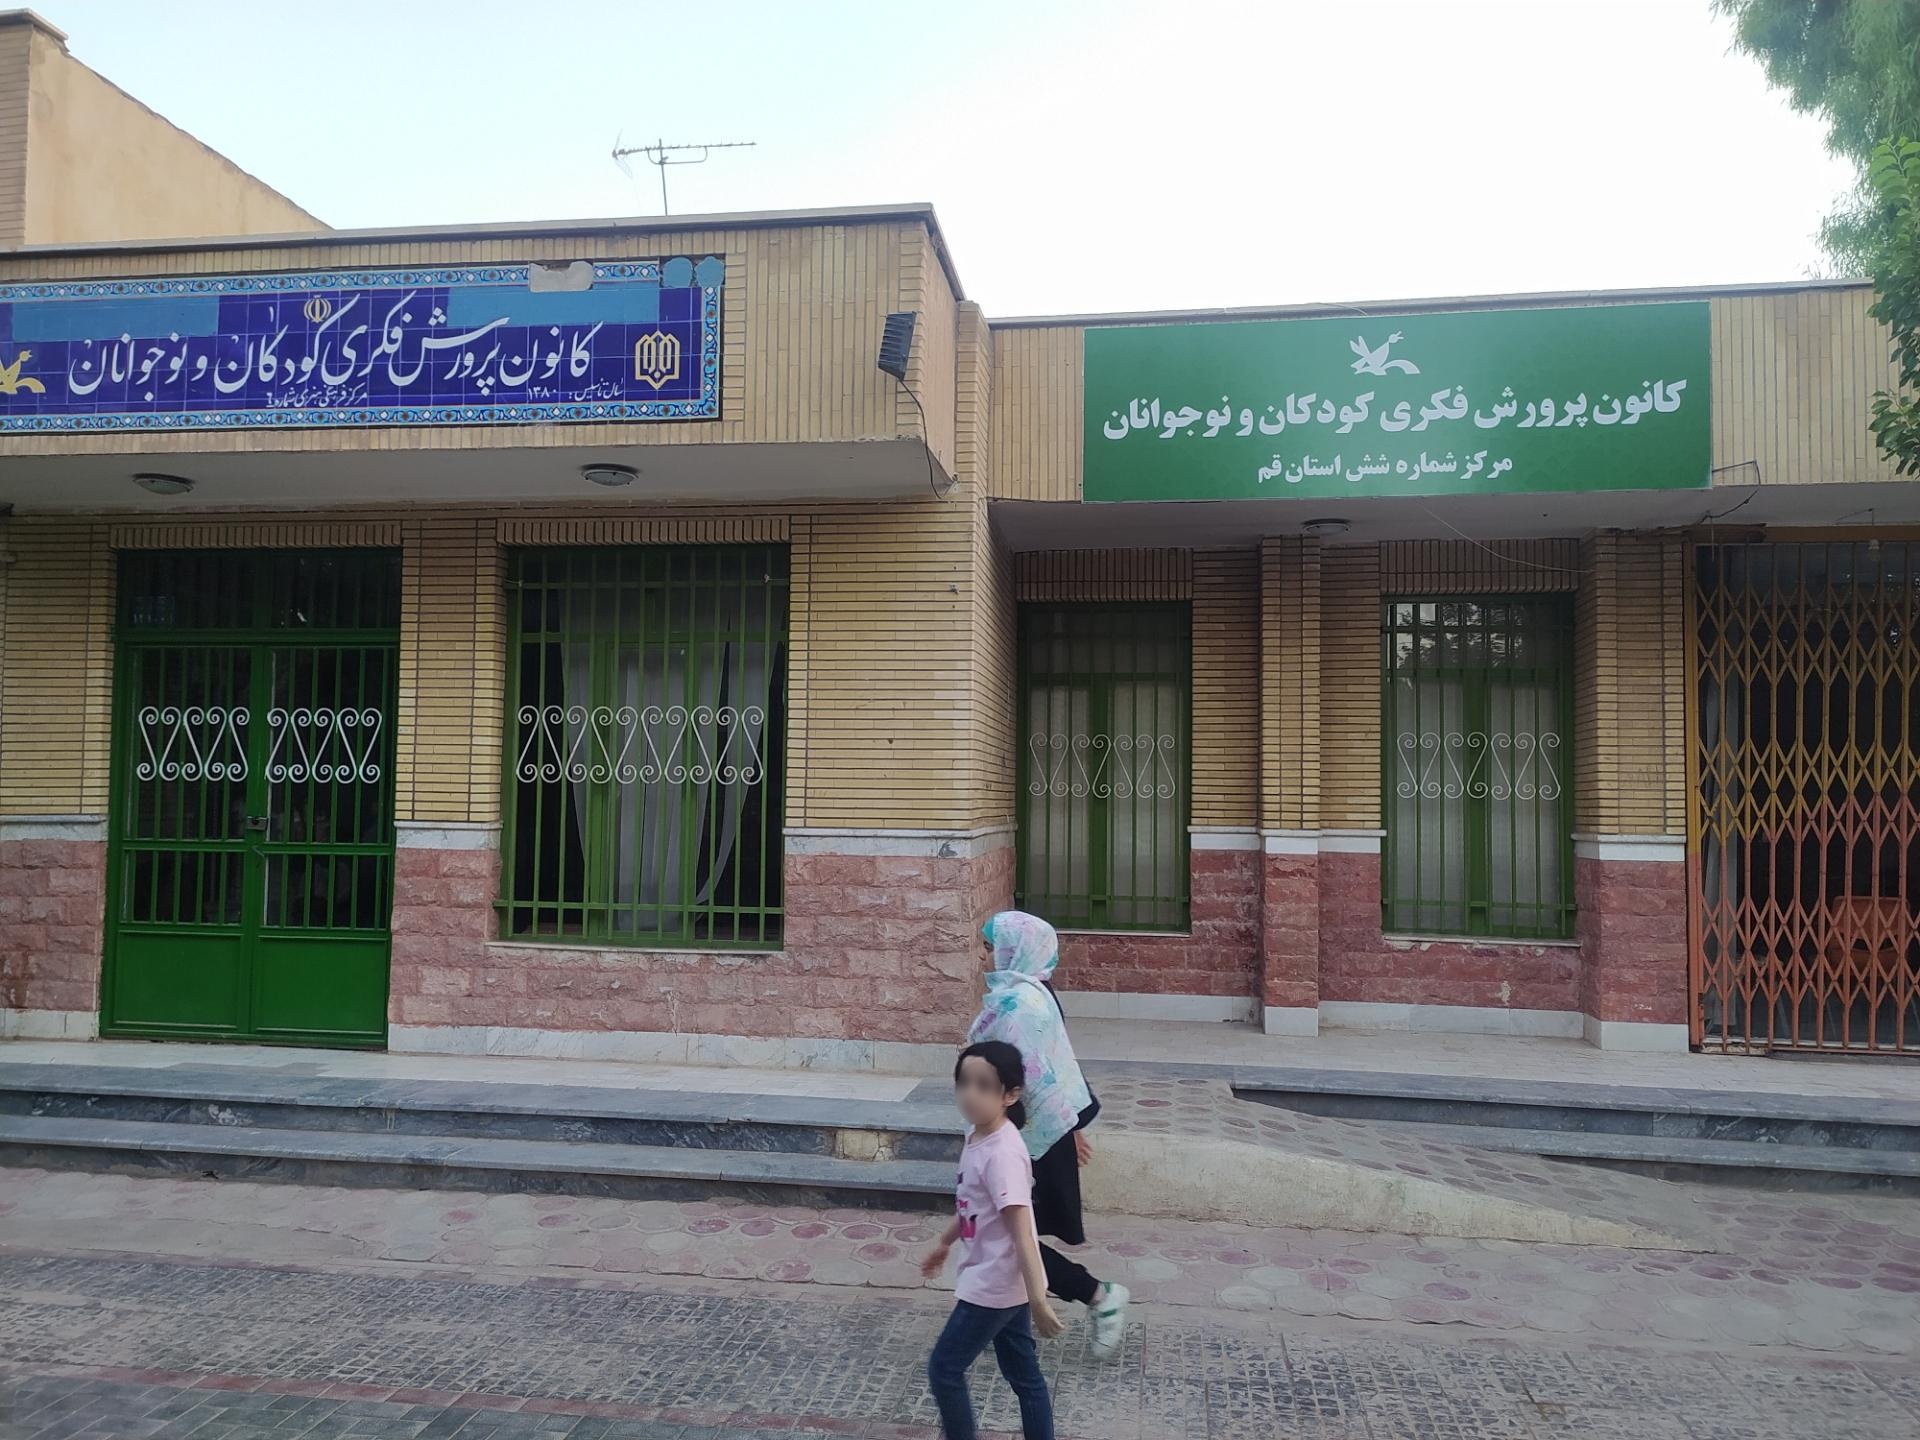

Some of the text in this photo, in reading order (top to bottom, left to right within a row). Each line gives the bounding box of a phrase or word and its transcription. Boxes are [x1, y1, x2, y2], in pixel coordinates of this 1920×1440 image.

[68, 289, 604, 402] کانون پرورش فکری کودکان و نوجوانان
[344, 382, 368, 406] مرکز
[528, 386, 557, 400] ۱۳۸۰
[1103, 379, 1687, 440] کانون پرورش فکری کودکان و نوجوانان
[1257, 450, 1513, 484] مرکز شماره شش استان قم
